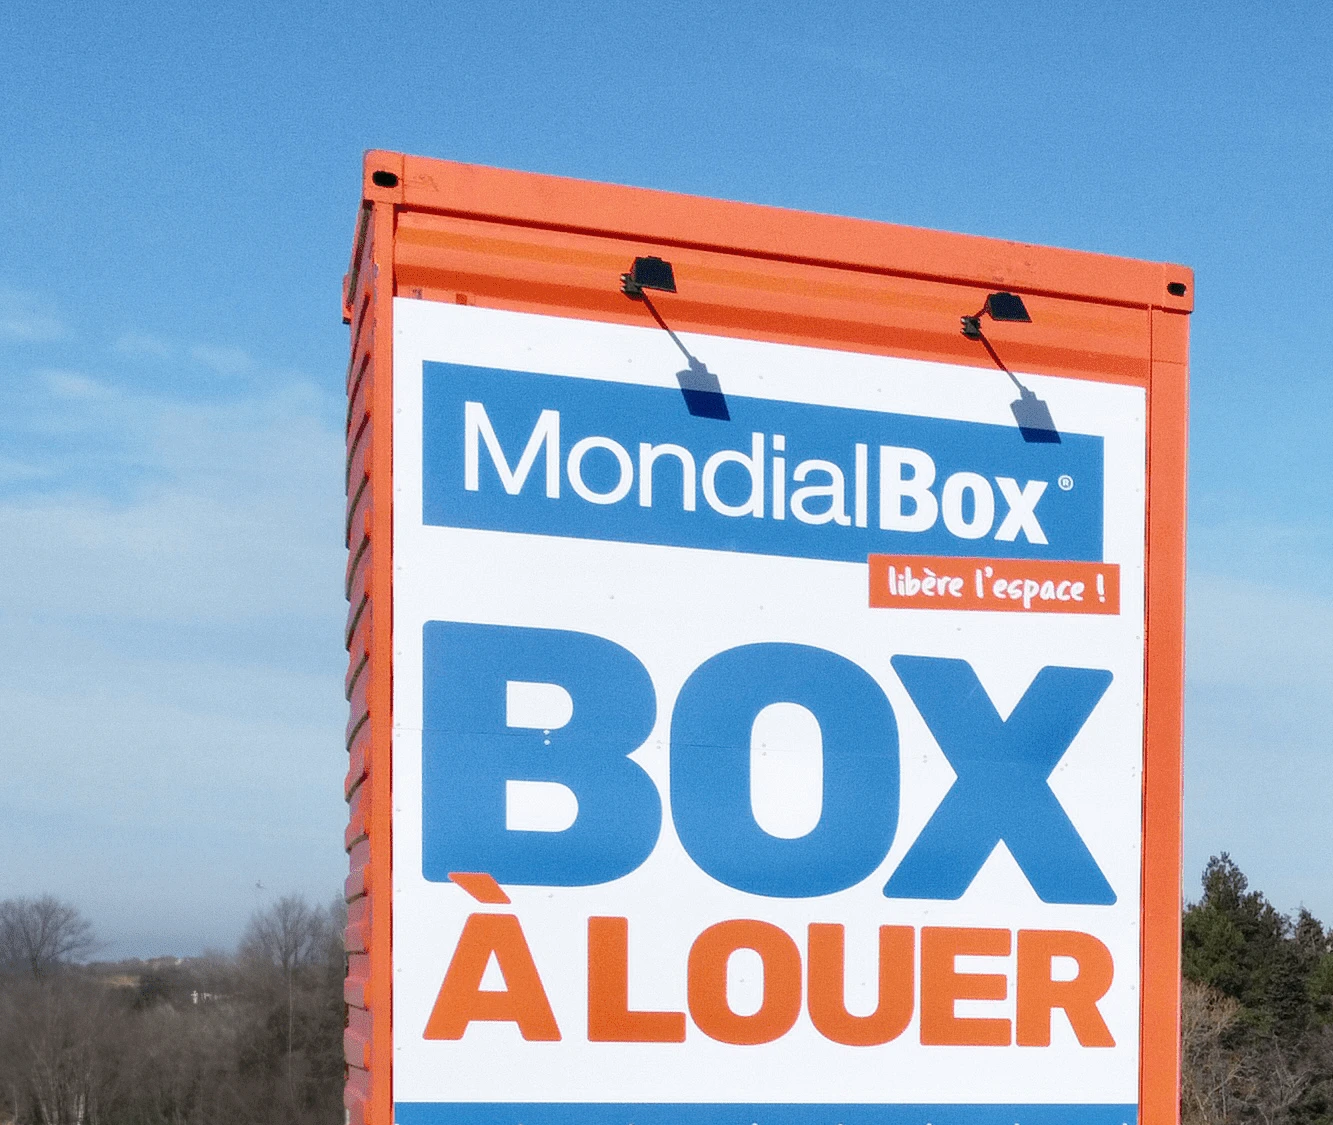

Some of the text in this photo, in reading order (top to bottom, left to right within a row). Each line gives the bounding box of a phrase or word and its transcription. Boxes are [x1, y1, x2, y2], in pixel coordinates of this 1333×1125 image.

[888, 565, 964, 597] libère
[975, 565, 1085, 609] l'espace
[422, 619, 1118, 906] BOX
[422, 872, 1116, 1049] À LOUER
